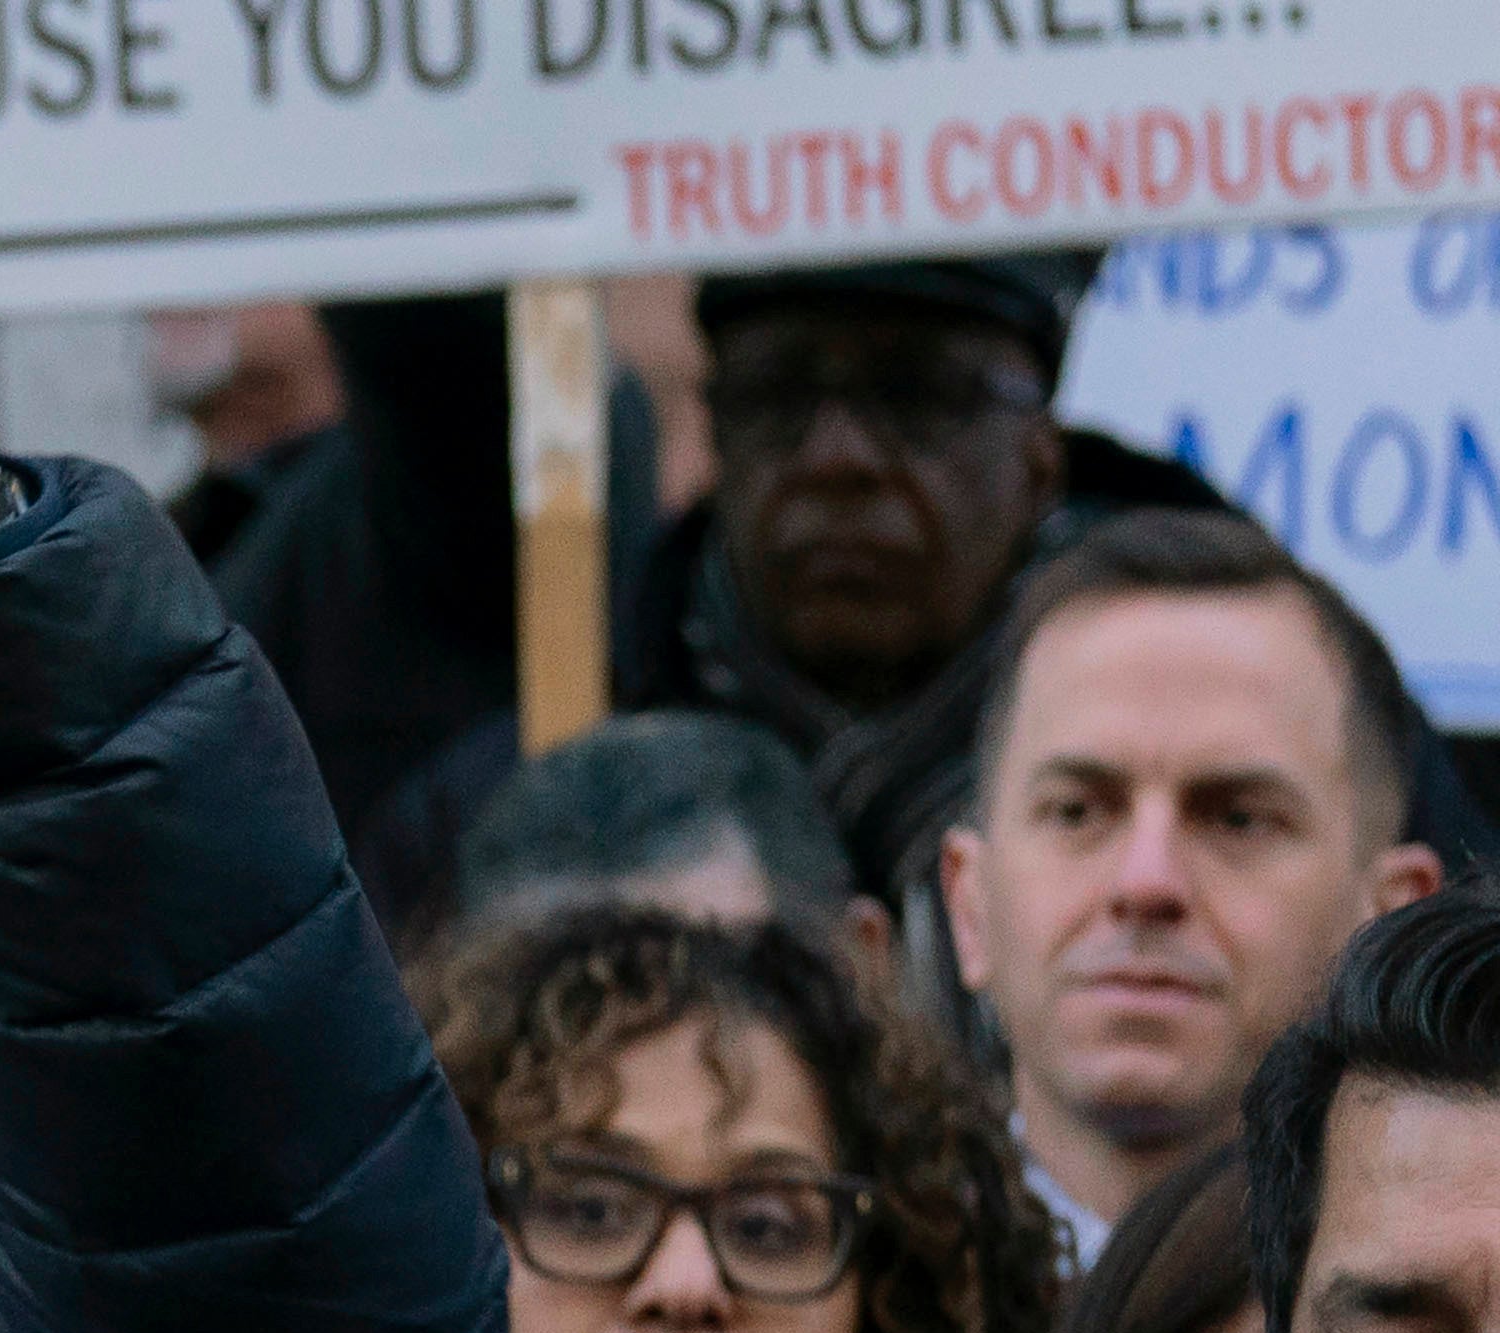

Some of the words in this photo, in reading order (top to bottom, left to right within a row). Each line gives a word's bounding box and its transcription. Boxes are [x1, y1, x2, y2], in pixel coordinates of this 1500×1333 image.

[236, 0, 478, 98] YOU
[610, 130, 902, 238] TRUTH
[924, 84, 1500, 222] CONDUCTOR
